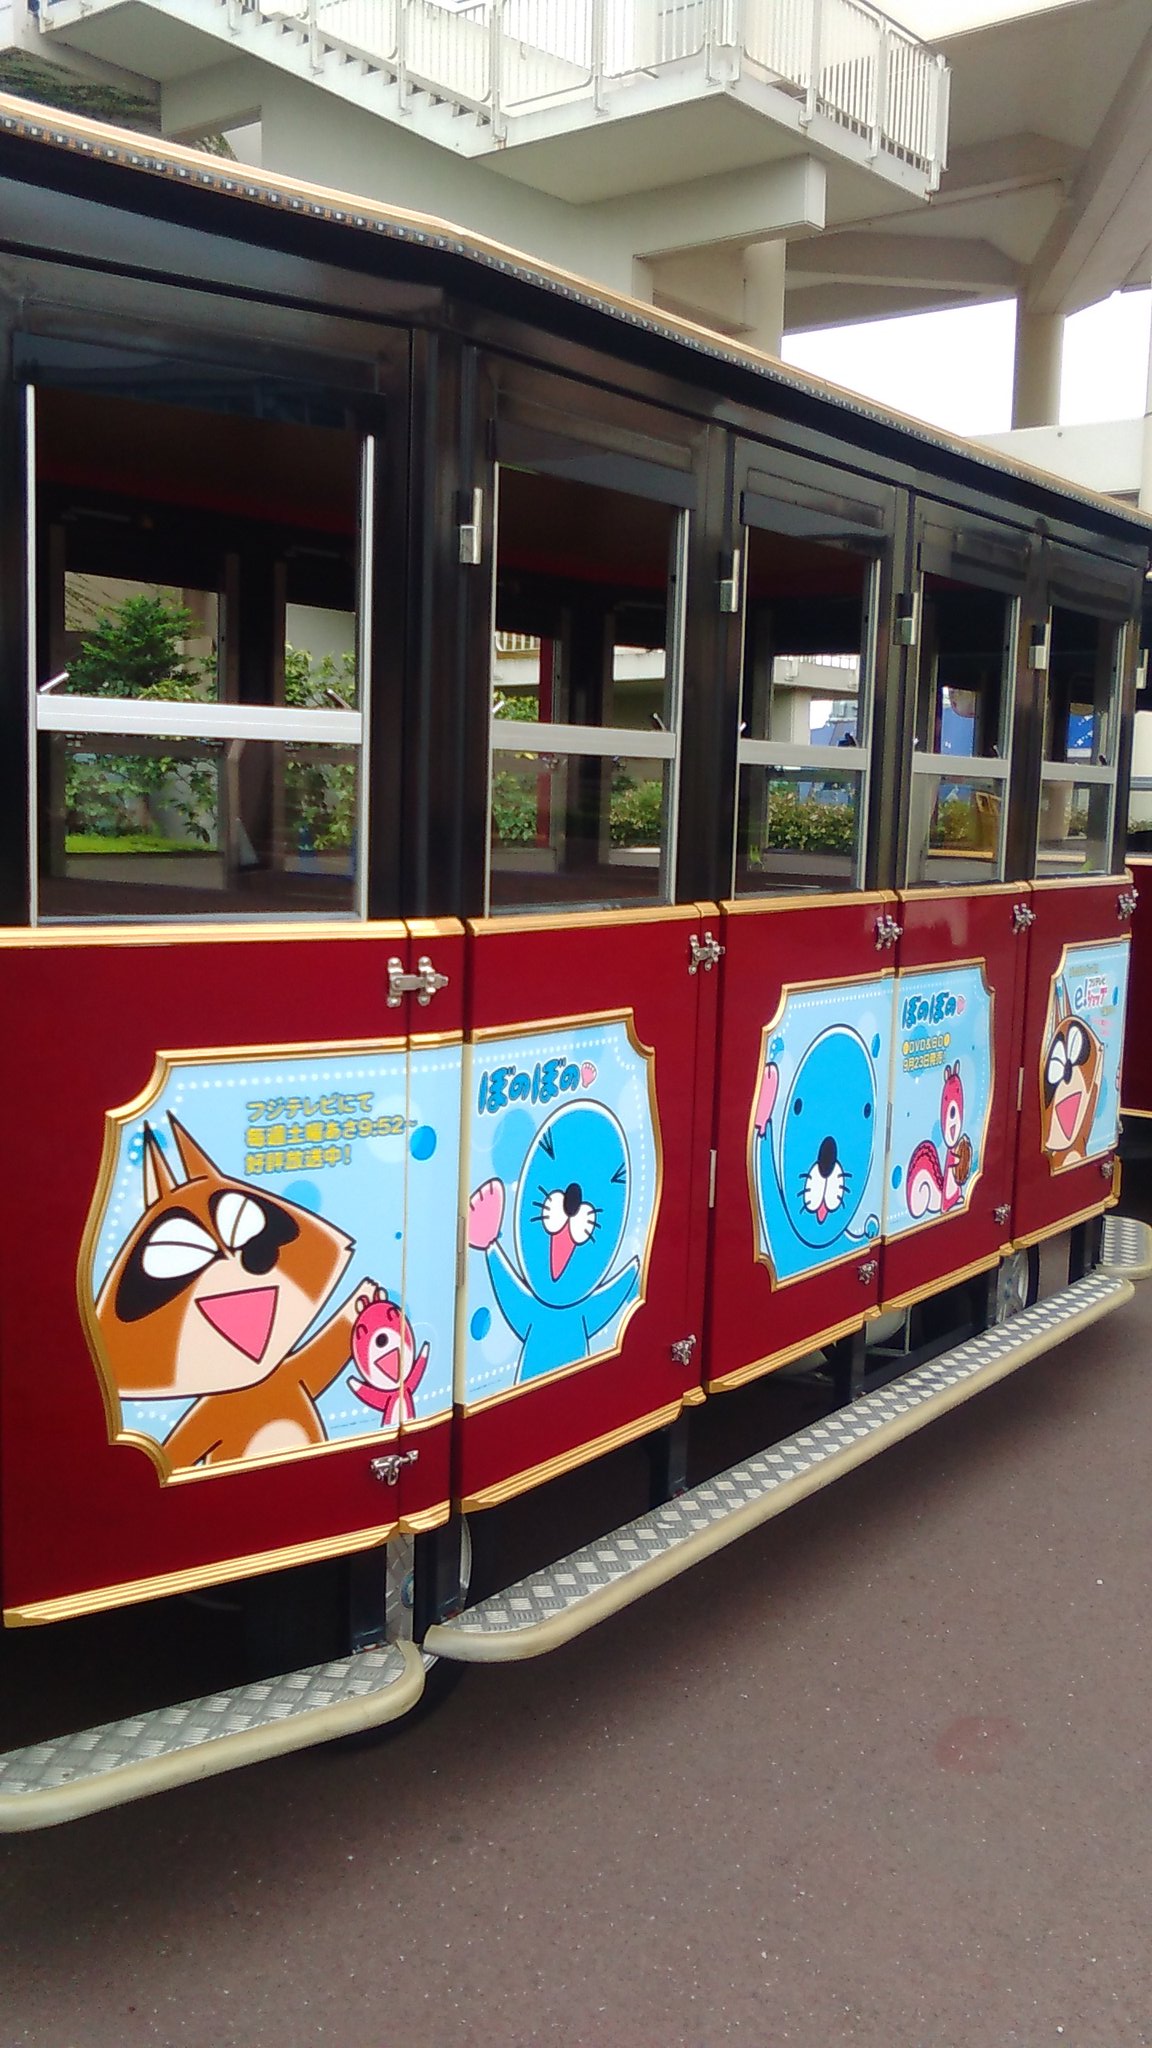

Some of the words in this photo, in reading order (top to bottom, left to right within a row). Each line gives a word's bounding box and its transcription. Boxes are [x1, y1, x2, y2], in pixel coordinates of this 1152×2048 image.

[901, 991, 957, 1031] ぼのぼの
[477, 1056, 581, 1115] ぼのぼの
[245, 1092, 374, 1122] フジテレビにて
